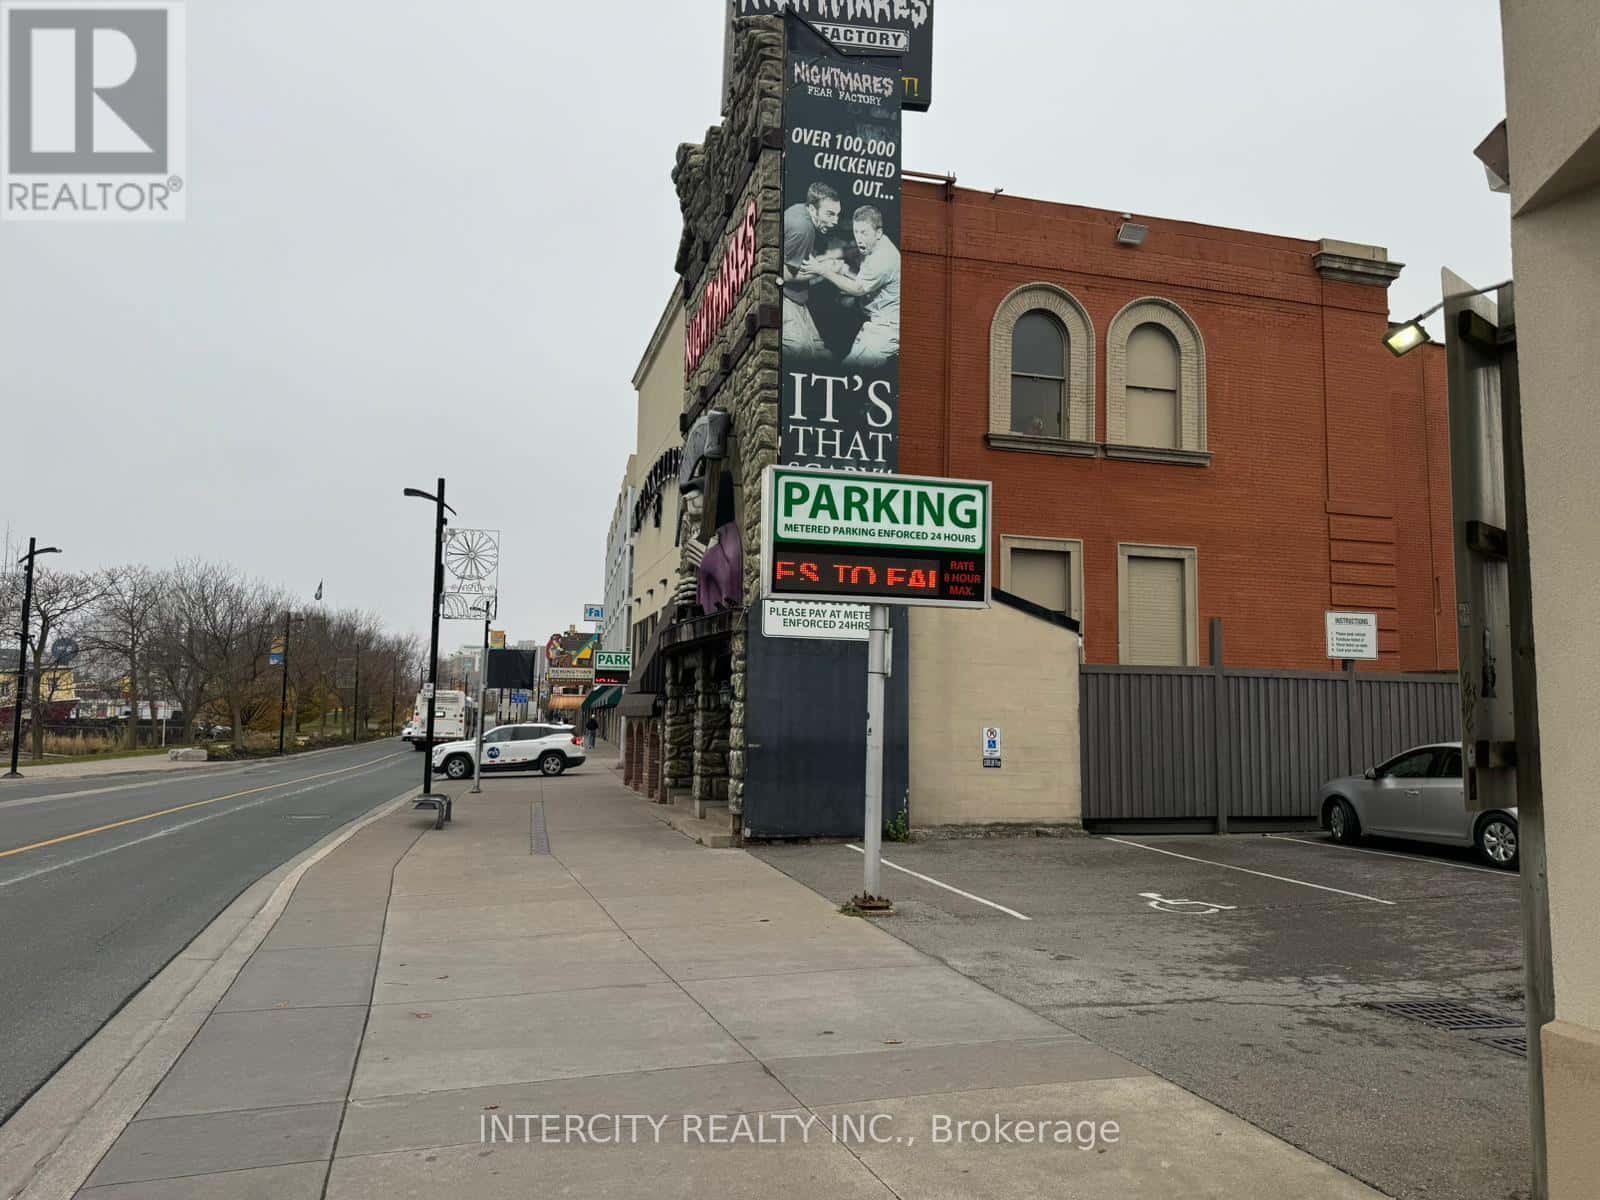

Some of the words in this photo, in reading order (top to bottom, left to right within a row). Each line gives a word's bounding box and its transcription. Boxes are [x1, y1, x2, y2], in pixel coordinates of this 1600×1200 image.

[794, 61, 894, 97] NIGHTMARES
[807, 85, 833, 98] FEAR
[839, 91, 882, 105] FACTORY
[791, 127, 831, 148] OVER
[835, 134, 895, 157] 100,000
[814, 152, 895, 179] CHICKENED
[853, 179, 894, 200] OUT...
[789, 372, 893, 427] IT'S
[789, 424, 893, 462] THAT
[783, 481, 977, 529] PARKING
[784, 523, 831, 534] METERED
[832, 526, 876, 537] PARKING
[877, 529, 928, 540] ENFORCED
[930, 532, 942, 541] 24
[943, 533, 977, 543] HOURS
[950, 561, 975, 571] RATE
[951, 574, 981, 584] HOUR
[949, 585, 975, 596] MAX.
[769, 607, 807, 617] PLEASE
[809, 608, 827, 618] PAY
[829, 609, 841, 619] AT
[783, 618, 836, 629] ENFORCED
[838, 620, 870, 631] 24HRS
